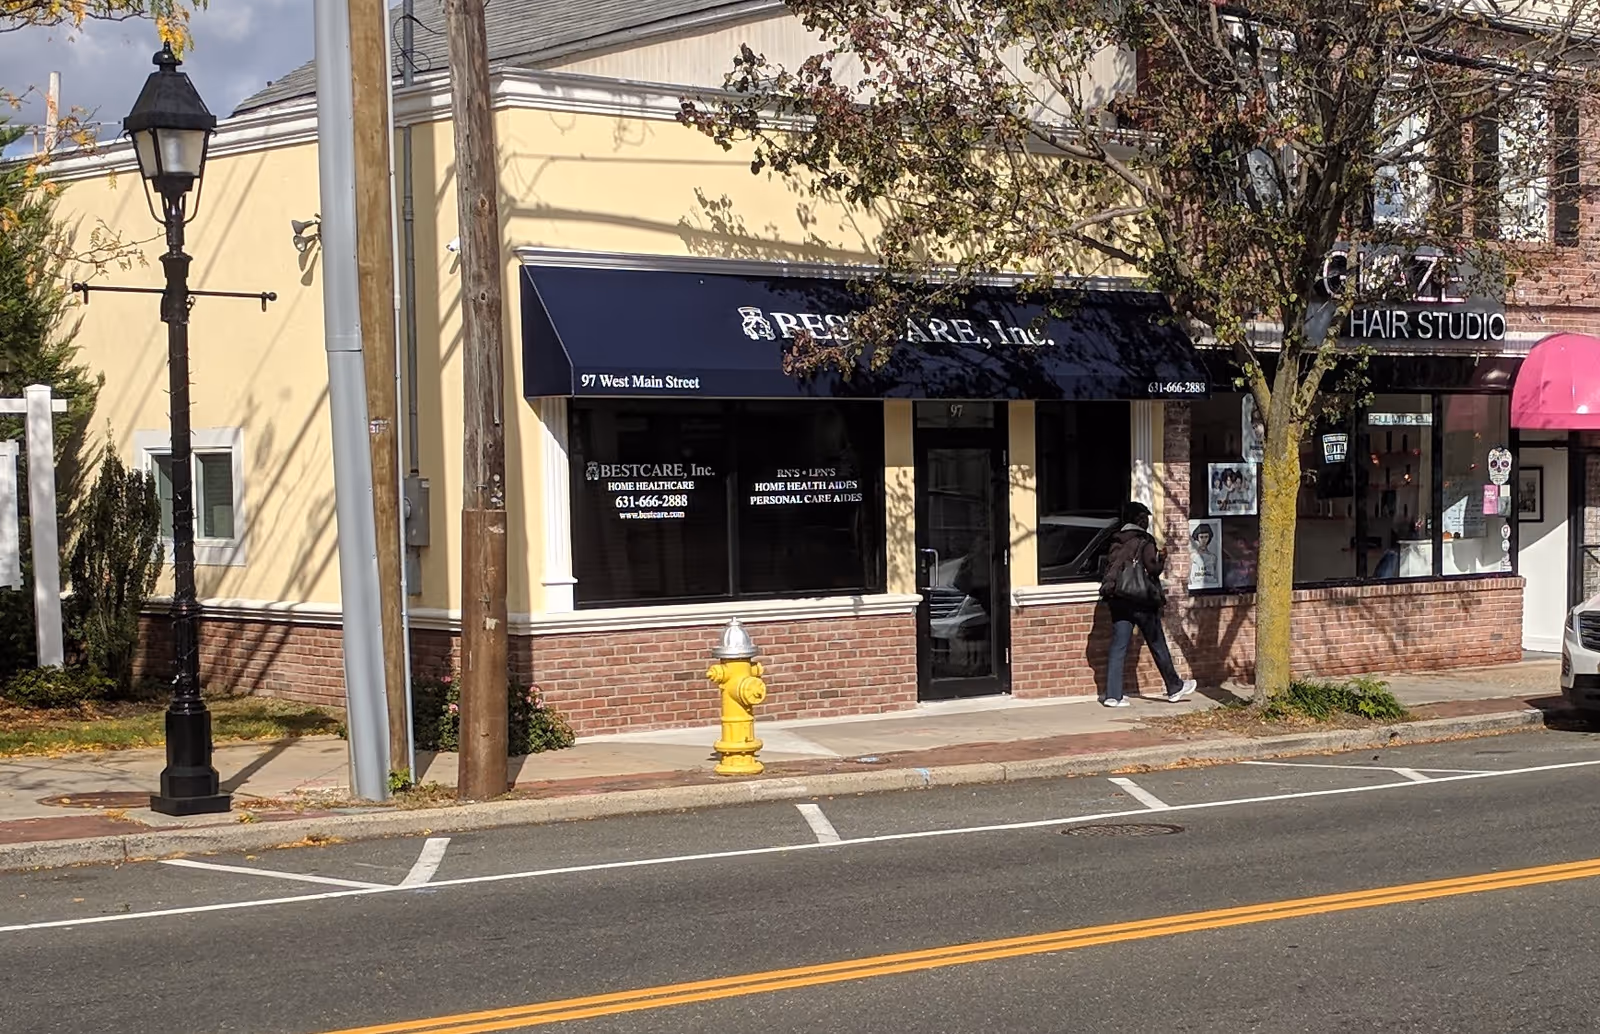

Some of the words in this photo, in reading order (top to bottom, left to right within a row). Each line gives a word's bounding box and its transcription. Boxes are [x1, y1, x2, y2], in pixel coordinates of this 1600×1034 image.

[769, 311, 992, 349] BESARE,
[987, 319, 1055, 346] Inc.
[1350, 309, 1409, 339] HAIR
[1417, 311, 1506, 341] STUDIO
[581, 374, 596, 387] 97
[599, 374, 630, 388] West
[632, 375, 663, 388] Main
[665, 375, 700, 389] Street
[1148, 381, 1206, 393] 631-666-2888
[950, 404, 963, 417] 97
[600, 463, 688, 479] BESTCARE,
[691, 463, 716, 476] Inc.
[776, 468, 800, 478] RN'S
[607, 481, 635, 491] HOME
[636, 481, 695, 491] HEALTHCARE
[755, 482, 785, 492] HOME
[786, 481, 827, 491] HEALTH
[828, 480, 858, 490] AIDES
[615, 494, 688, 508] 631-666-2888
[750, 495, 803, 505] PERSONAL
[804, 494, 832, 504] CARE
[833, 493, 863, 503] AIDES
[619, 510, 685, 519] www.bestcare.com
